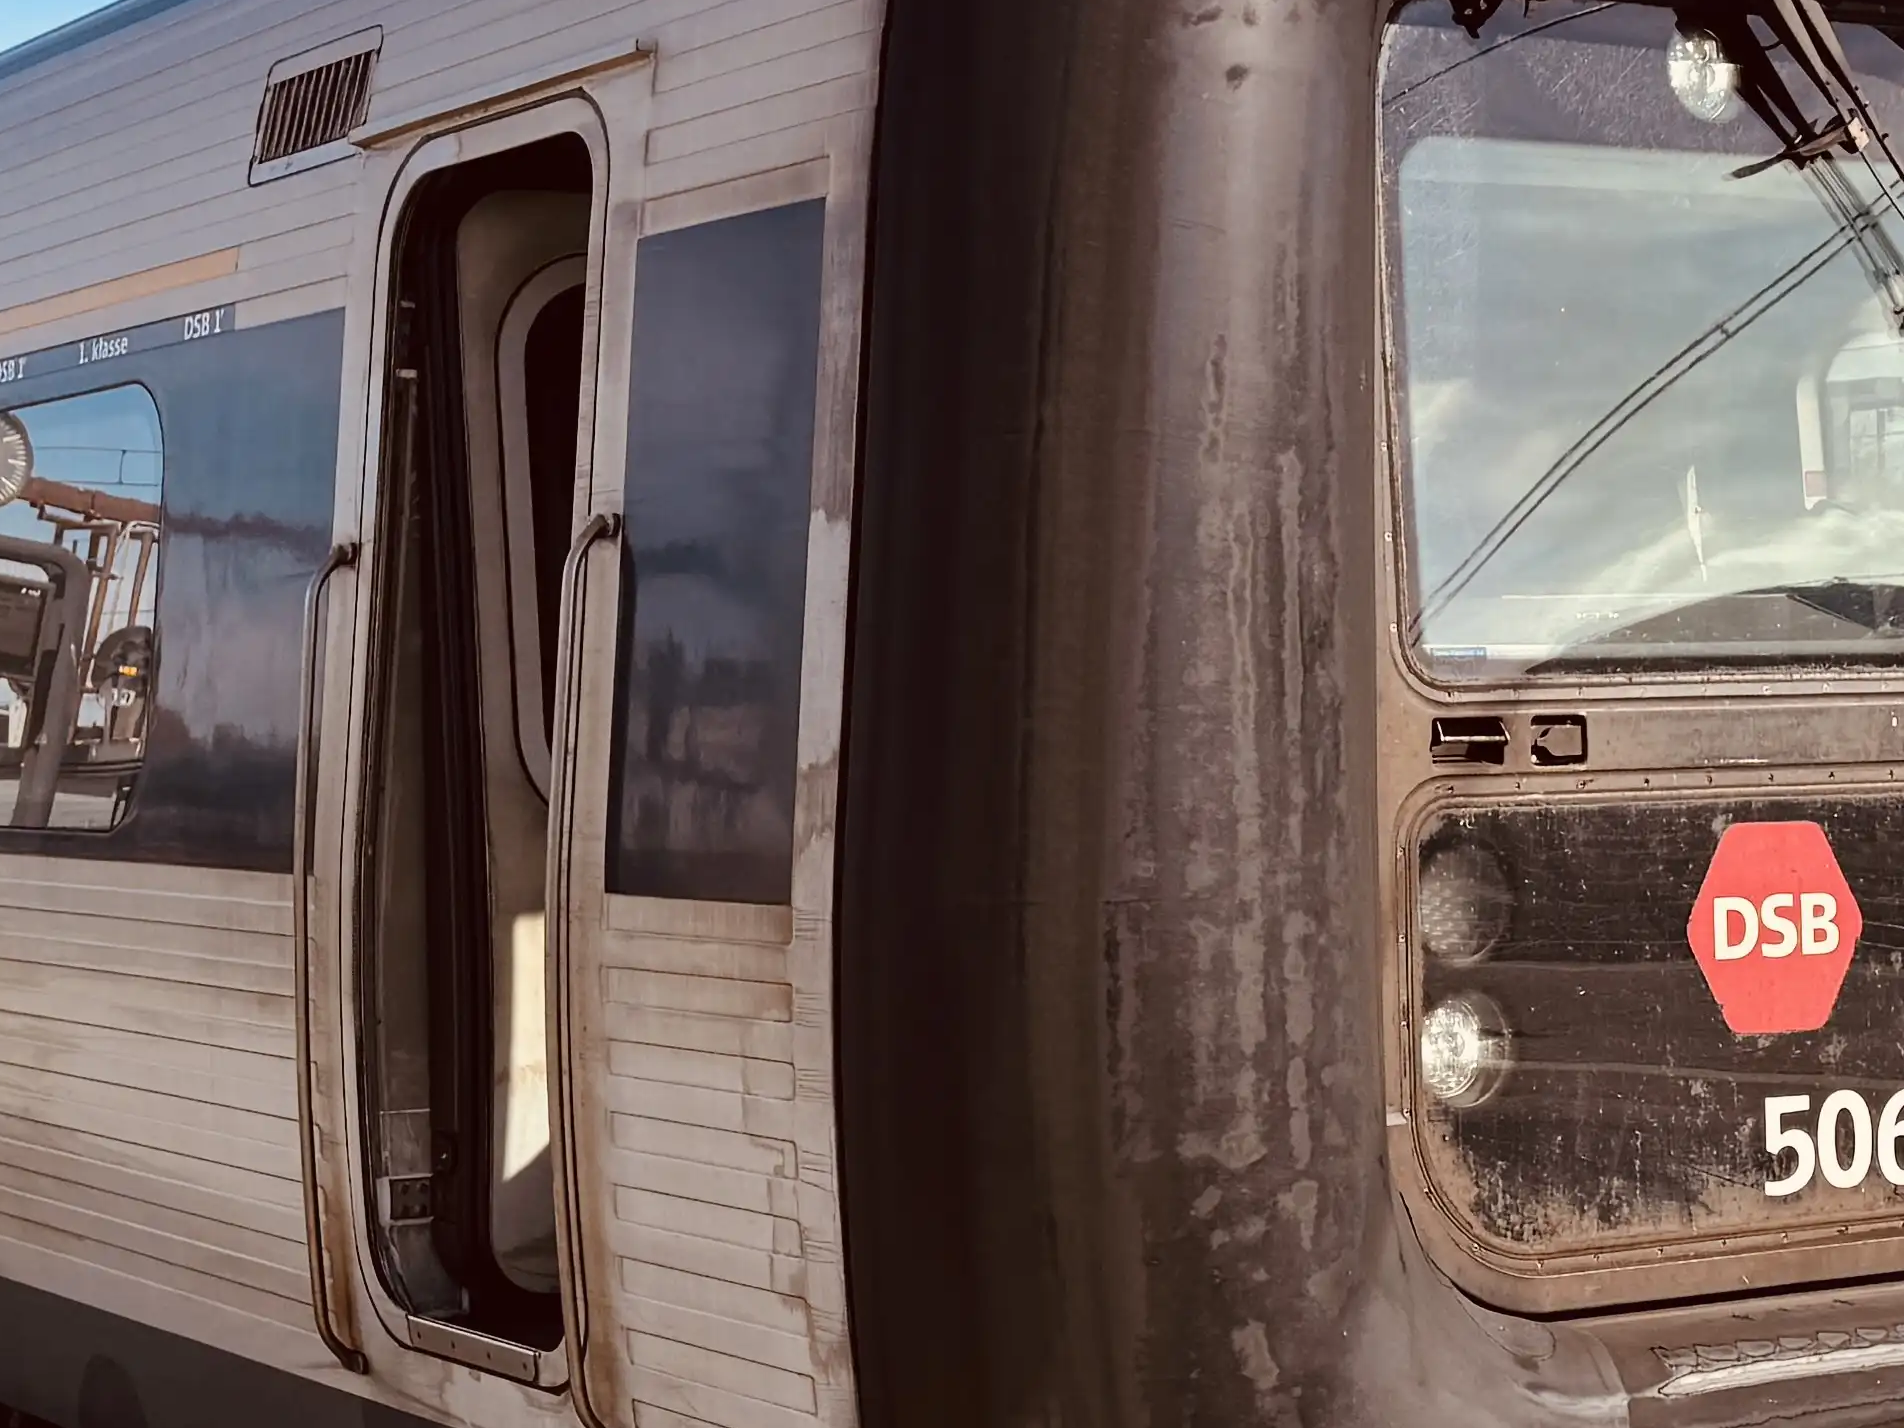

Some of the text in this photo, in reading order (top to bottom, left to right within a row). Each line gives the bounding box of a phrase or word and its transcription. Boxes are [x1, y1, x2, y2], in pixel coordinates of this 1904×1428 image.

[184, 312, 210, 340] DSB
[91, 336, 128, 361] klasse
[1711, 892, 1841, 961] DSB
